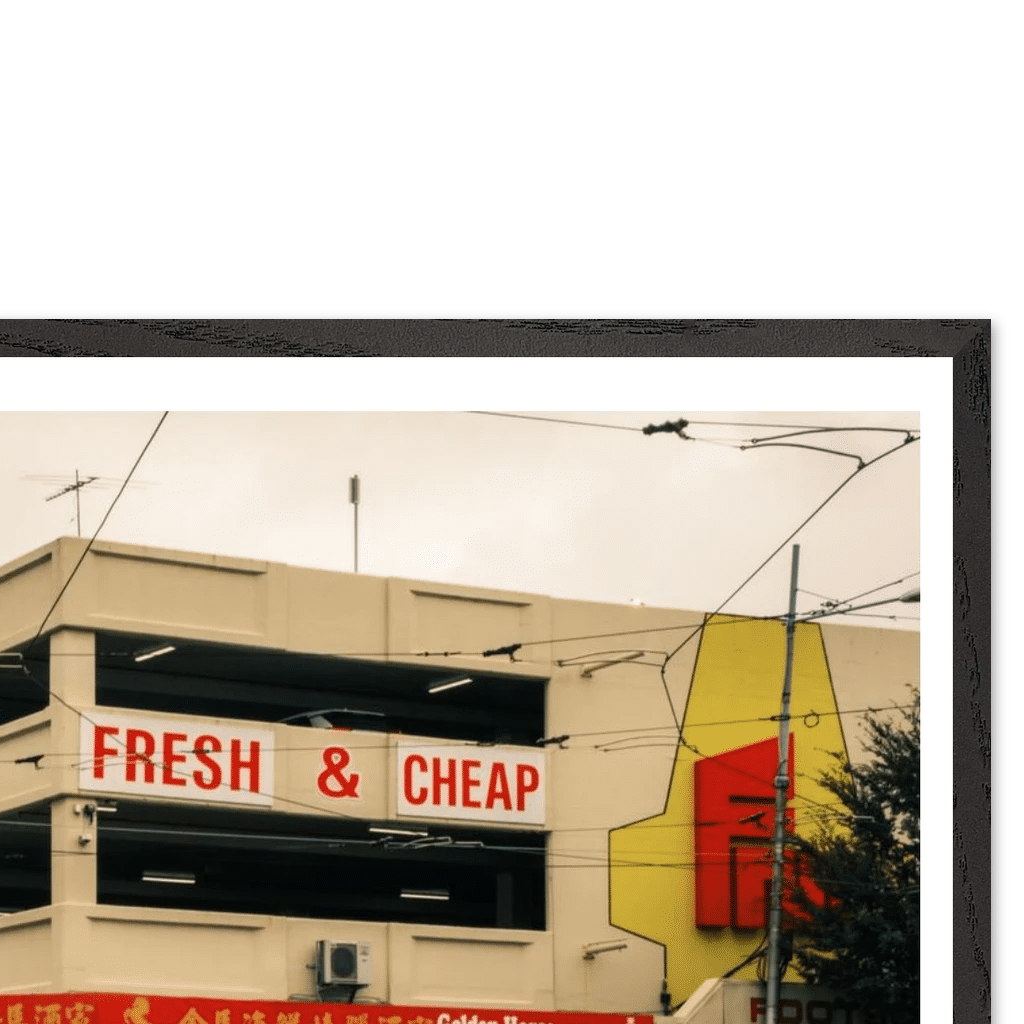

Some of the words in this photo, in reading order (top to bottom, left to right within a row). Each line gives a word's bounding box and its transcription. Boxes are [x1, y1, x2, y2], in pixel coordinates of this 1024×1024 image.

[93, 724, 261, 794] FRESH
[316, 745, 360, 799] &
[403, 754, 540, 812] CHEAP
